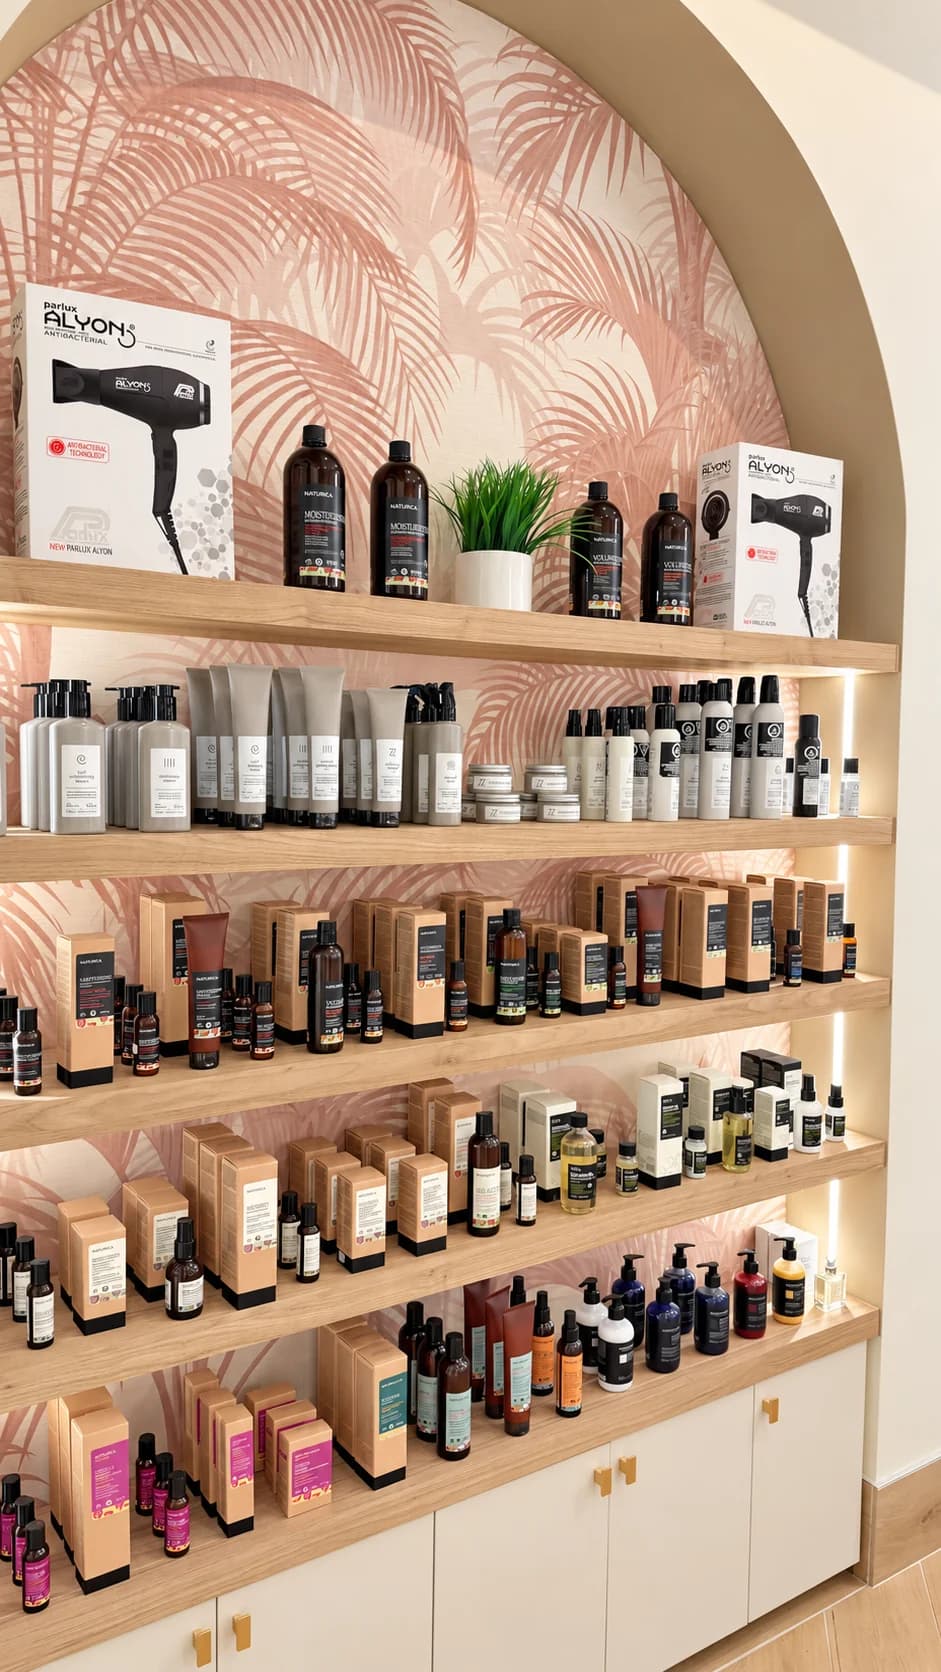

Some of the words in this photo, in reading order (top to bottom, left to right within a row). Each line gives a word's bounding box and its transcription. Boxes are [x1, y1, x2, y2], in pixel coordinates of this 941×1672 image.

[44, 302, 77, 312] parlux
[44, 310, 124, 336] ALYON
[44, 330, 108, 345] ANTIBACTERIAL
[748, 460, 790, 476] ALYON
[49, 543, 65, 551] NEW
[66, 544, 91, 554] PARLUX
[92, 547, 113, 556] ALYON
